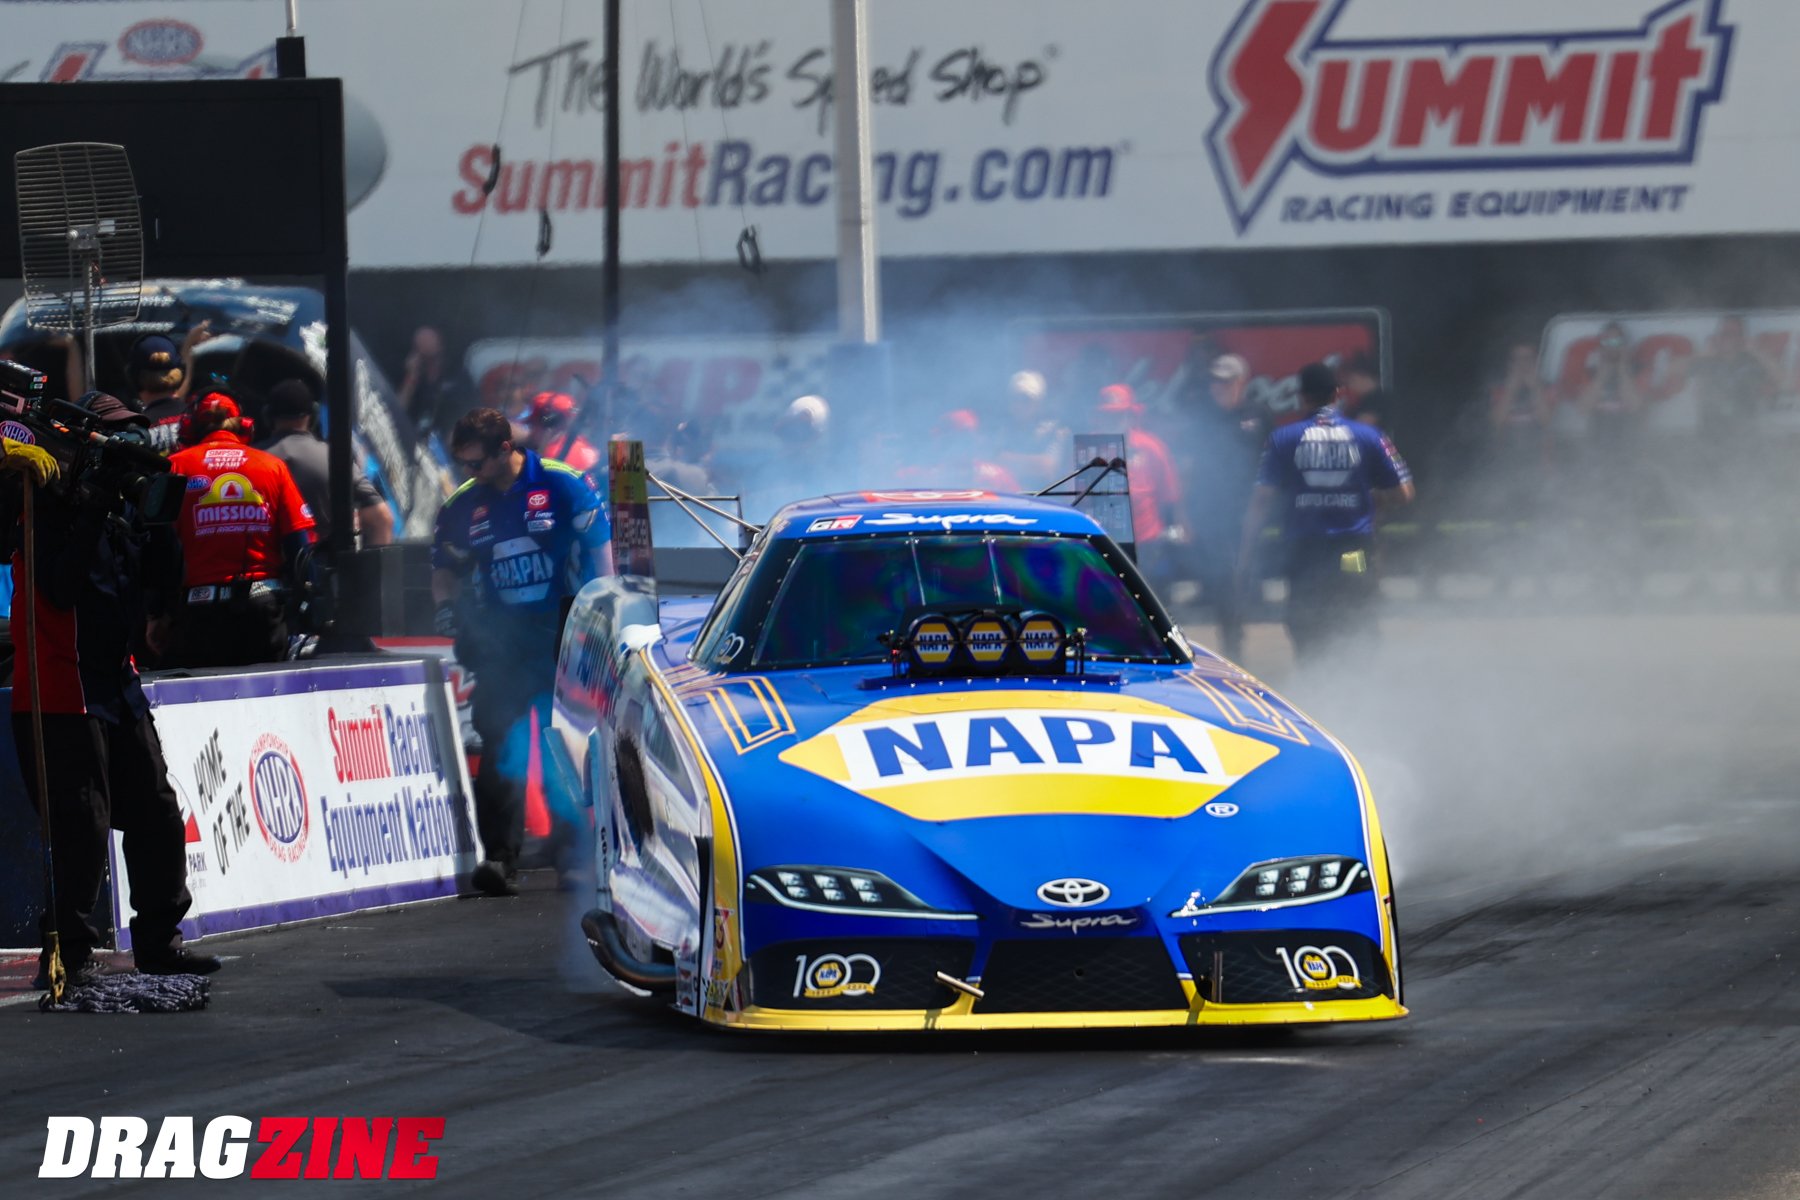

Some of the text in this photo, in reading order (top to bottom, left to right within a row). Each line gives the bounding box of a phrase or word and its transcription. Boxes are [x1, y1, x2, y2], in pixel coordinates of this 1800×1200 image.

[508, 38, 1044, 137] The World's Sped Shop
[452, 140, 1118, 219] SummitRacng.com
[1280, 184, 1690, 223] RACING EQUIPMENT
[3, 425, 30, 444] NHRA
[808, 512, 1039, 532] GR Supra
[497, 552, 546, 588] NAPA
[919, 634, 949, 652] NAPA
[972, 633, 1002, 650] NAPA
[1025, 632, 1056, 650] NAPA
[328, 702, 446, 787] Summit Racing
[863, 716, 1208, 777] NAPA
[193, 727, 227, 815] HOME
[256, 754, 303, 841] NHRA
[213, 781, 250, 876] OF THE
[320, 783, 475, 880] Equipment Nations
[188, 851, 207, 875] PARK
[1020, 913, 1138, 935] Supra
